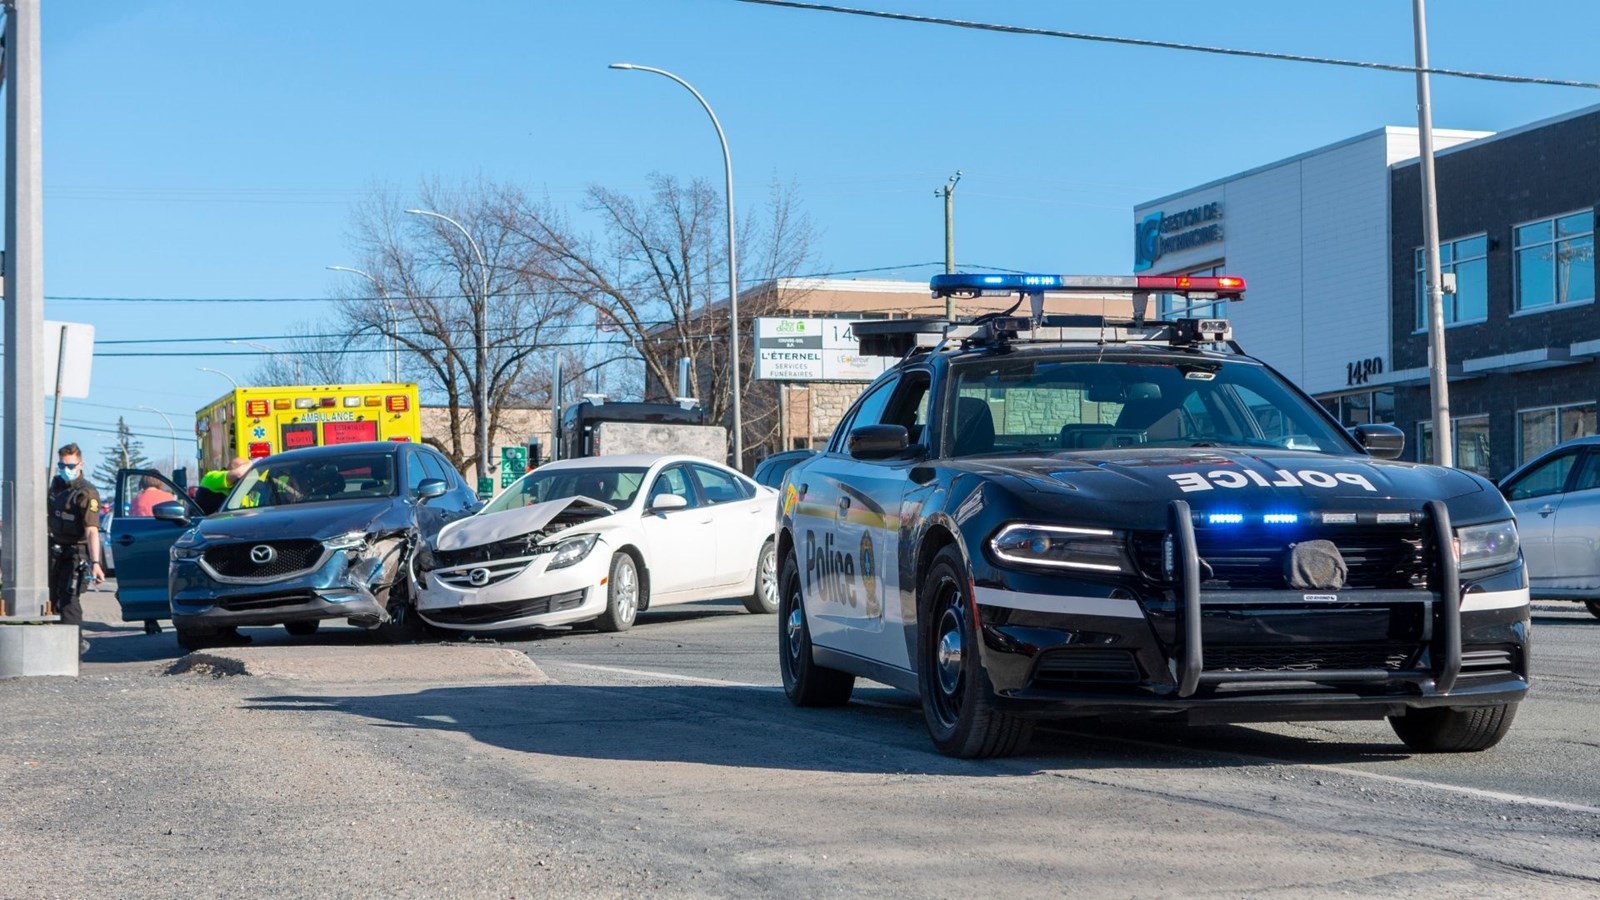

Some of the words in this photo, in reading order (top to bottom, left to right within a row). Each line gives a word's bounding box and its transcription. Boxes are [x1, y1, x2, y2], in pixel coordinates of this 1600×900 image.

[833, 326, 860, 342] 14
[761, 351, 821, 360] L'ÉTERNEL
[1346, 357, 1382, 386] 1480
[301, 411, 354, 422] AMBULANCE
[806, 529, 857, 608] Police
